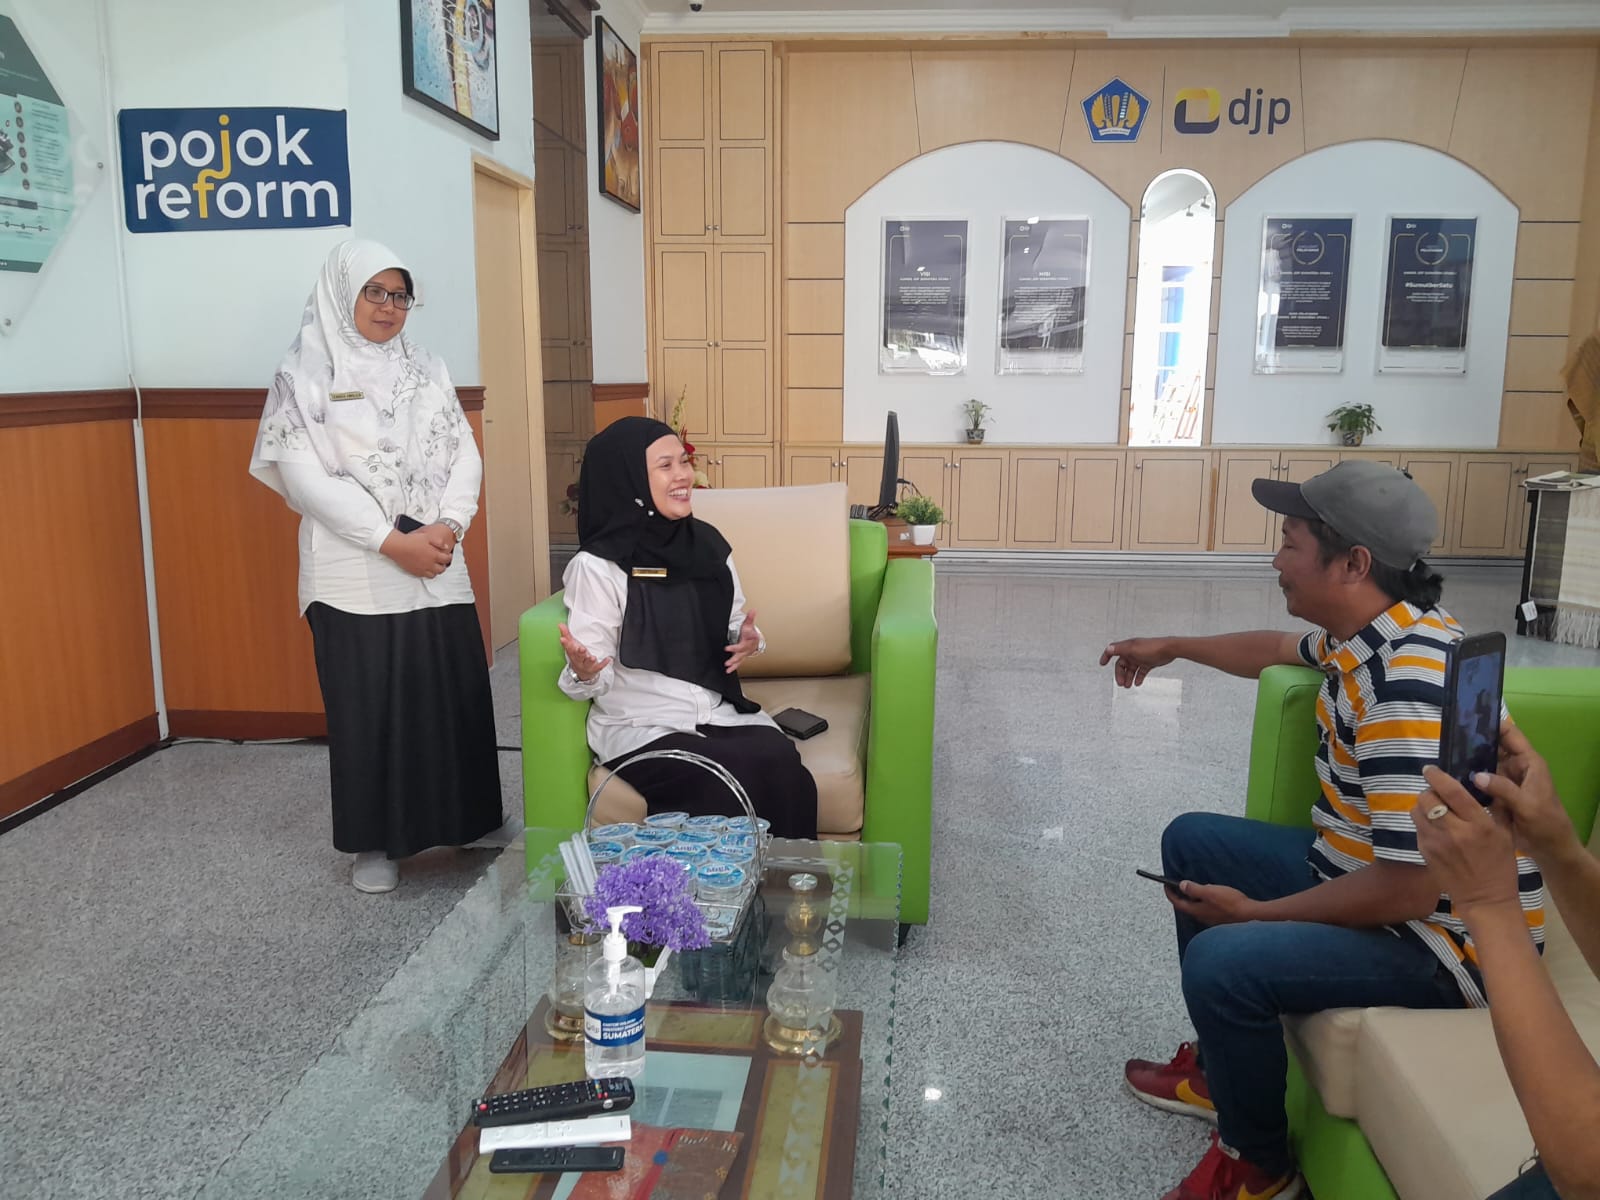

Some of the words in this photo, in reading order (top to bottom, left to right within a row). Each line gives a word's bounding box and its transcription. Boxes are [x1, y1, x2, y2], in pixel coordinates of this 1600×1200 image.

[1228, 88, 1291, 135] djp
[141, 114, 313, 181] pojok
[136, 169, 339, 220] reform
